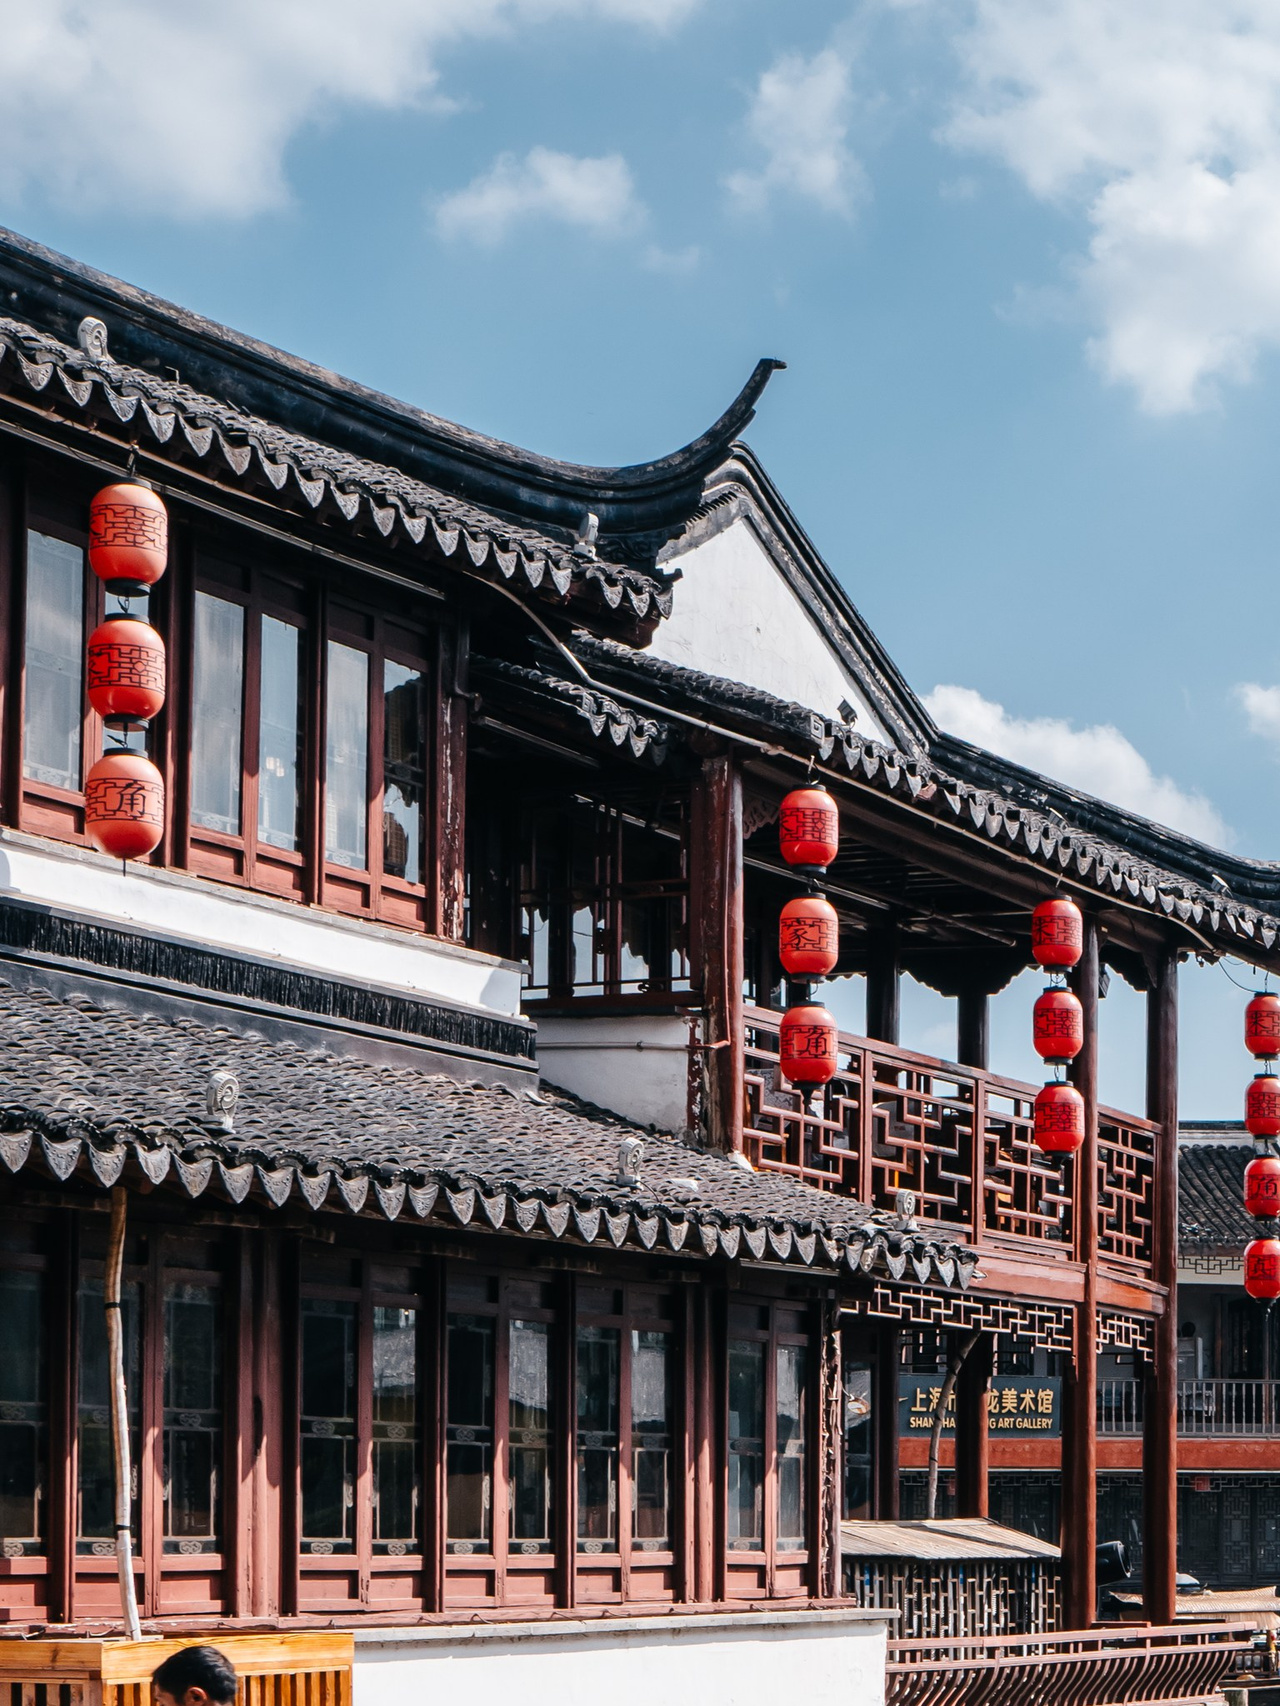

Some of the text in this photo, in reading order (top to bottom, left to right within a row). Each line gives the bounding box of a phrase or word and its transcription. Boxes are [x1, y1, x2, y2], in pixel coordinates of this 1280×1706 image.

[117, 782, 147, 819] 角
[782, 917, 814, 945] 家
[803, 1026, 829, 1056] 角
[998, 1418, 1015, 1429] ART
[1016, 1418, 1053, 1429] GALLERY
